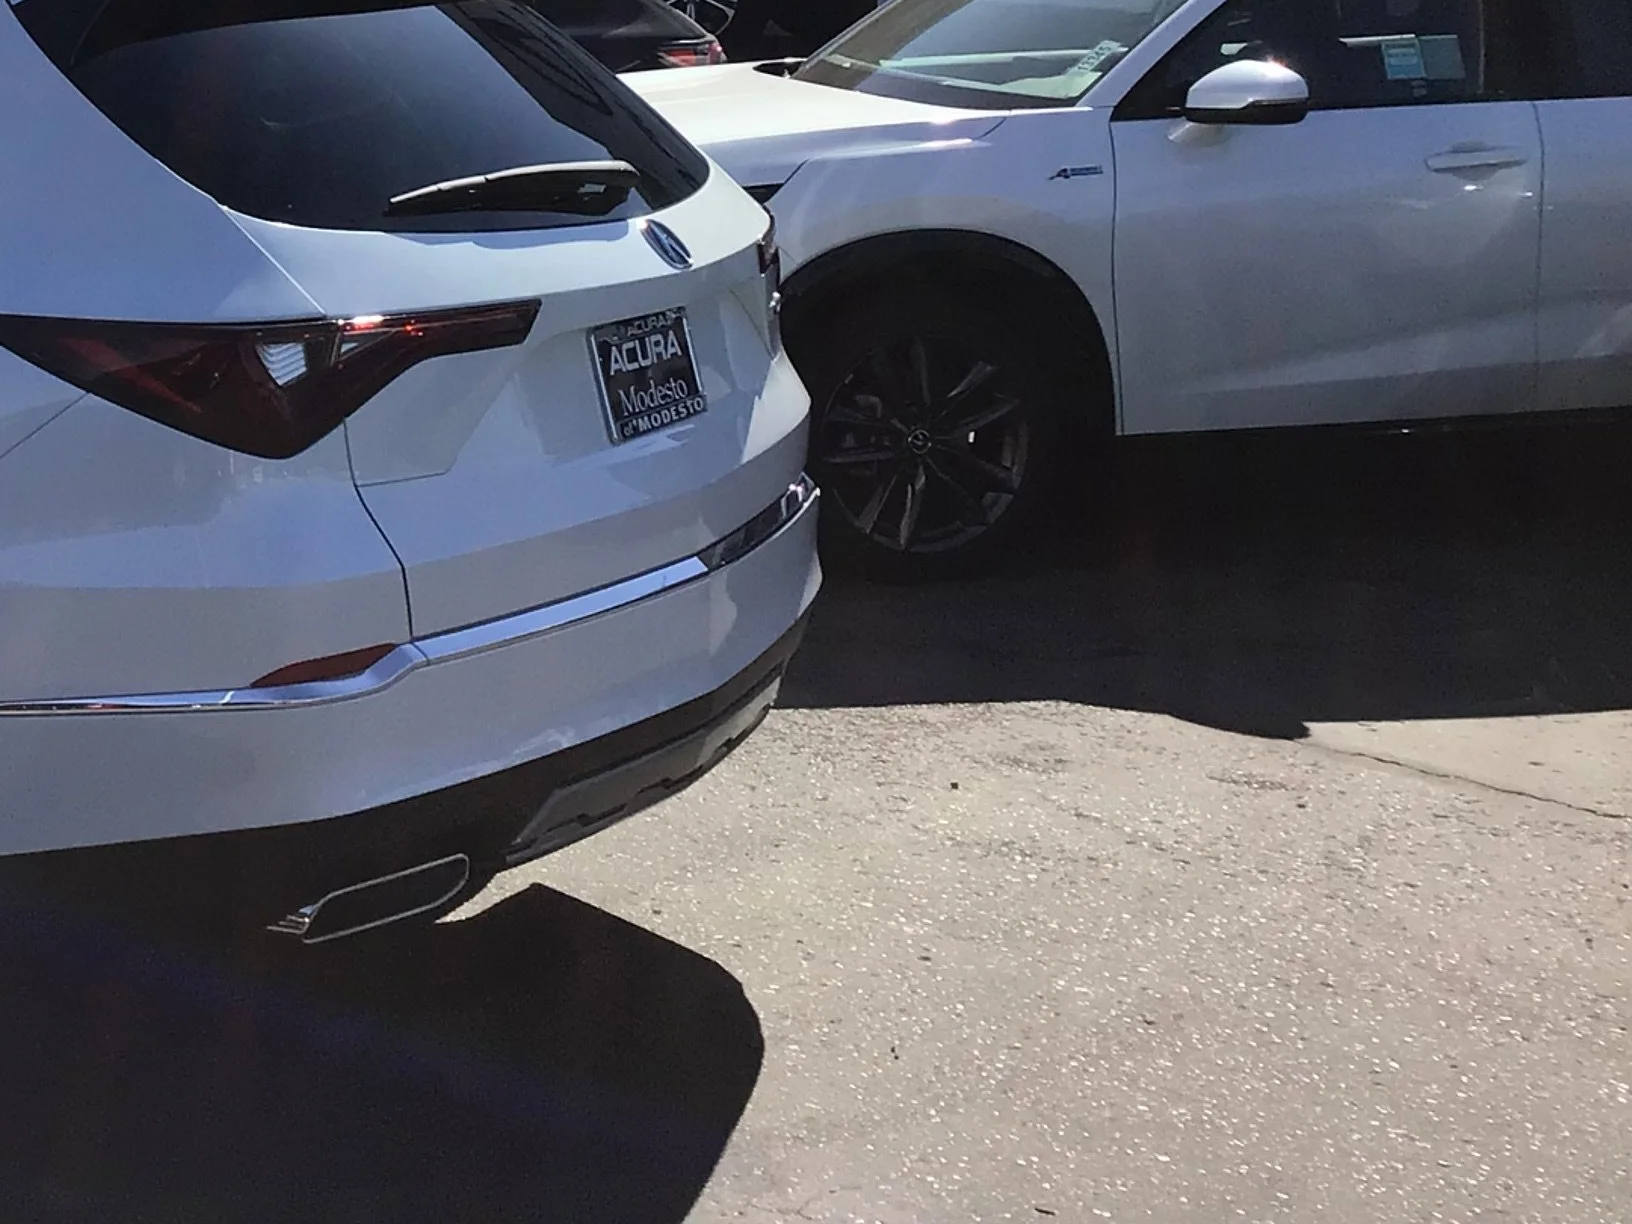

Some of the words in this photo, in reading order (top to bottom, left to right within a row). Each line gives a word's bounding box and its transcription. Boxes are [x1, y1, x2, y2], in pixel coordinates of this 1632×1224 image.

[627, 314, 669, 337] ACURA
[610, 329, 683, 376] ACURA
[618, 377, 688, 416] Modesto
[638, 397, 704, 432] MODESTO
